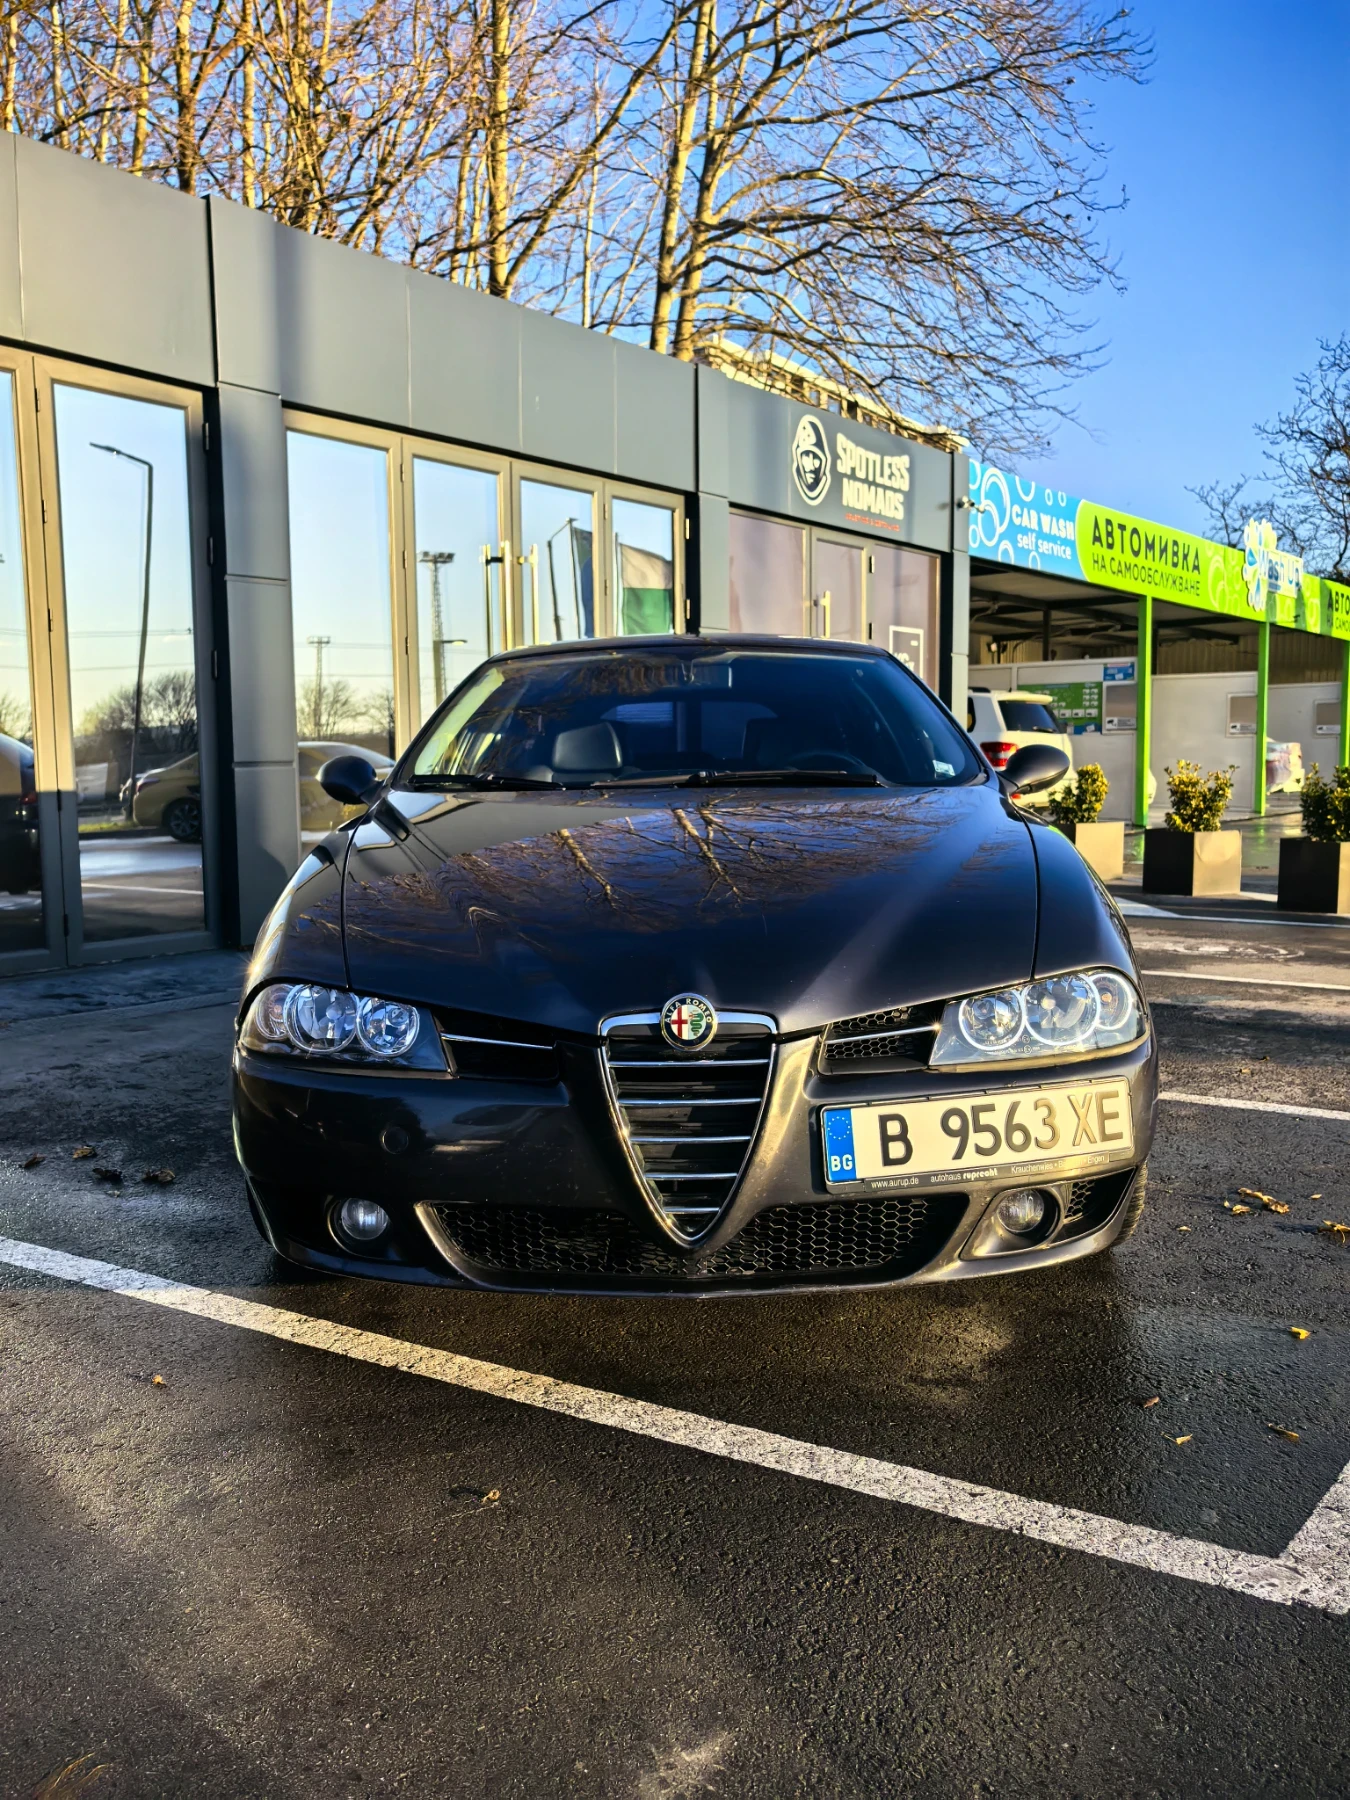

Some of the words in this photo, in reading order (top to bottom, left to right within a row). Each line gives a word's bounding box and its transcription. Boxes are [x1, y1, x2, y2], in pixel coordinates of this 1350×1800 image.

[836, 432, 909, 491] SPOTLESS
[842, 477, 904, 520] NOMADS
[1011, 504, 1039, 531] CAR
[1040, 512, 1075, 541] WASH
[1017, 531, 1036, 551] self
[1037, 539, 1072, 560] service
[1092, 515, 1201, 575] АВТОМИВКА
[1092, 552, 1107, 573] НА
[1109, 557, 1200, 597] САМООБСЛУЖВАНЕ
[665, 1001, 682, 1024] ALFA
[686, 998, 713, 1023] ROMEO
[878, 1113, 913, 1167] B
[940, 1097, 1060, 1161] 9563
[1067, 1090, 1123, 1147] XE
[830, 1155, 853, 1171] BG
[871, 1176, 919, 1189] www.aurup.de
[930, 1173, 962, 1183] autohaus
